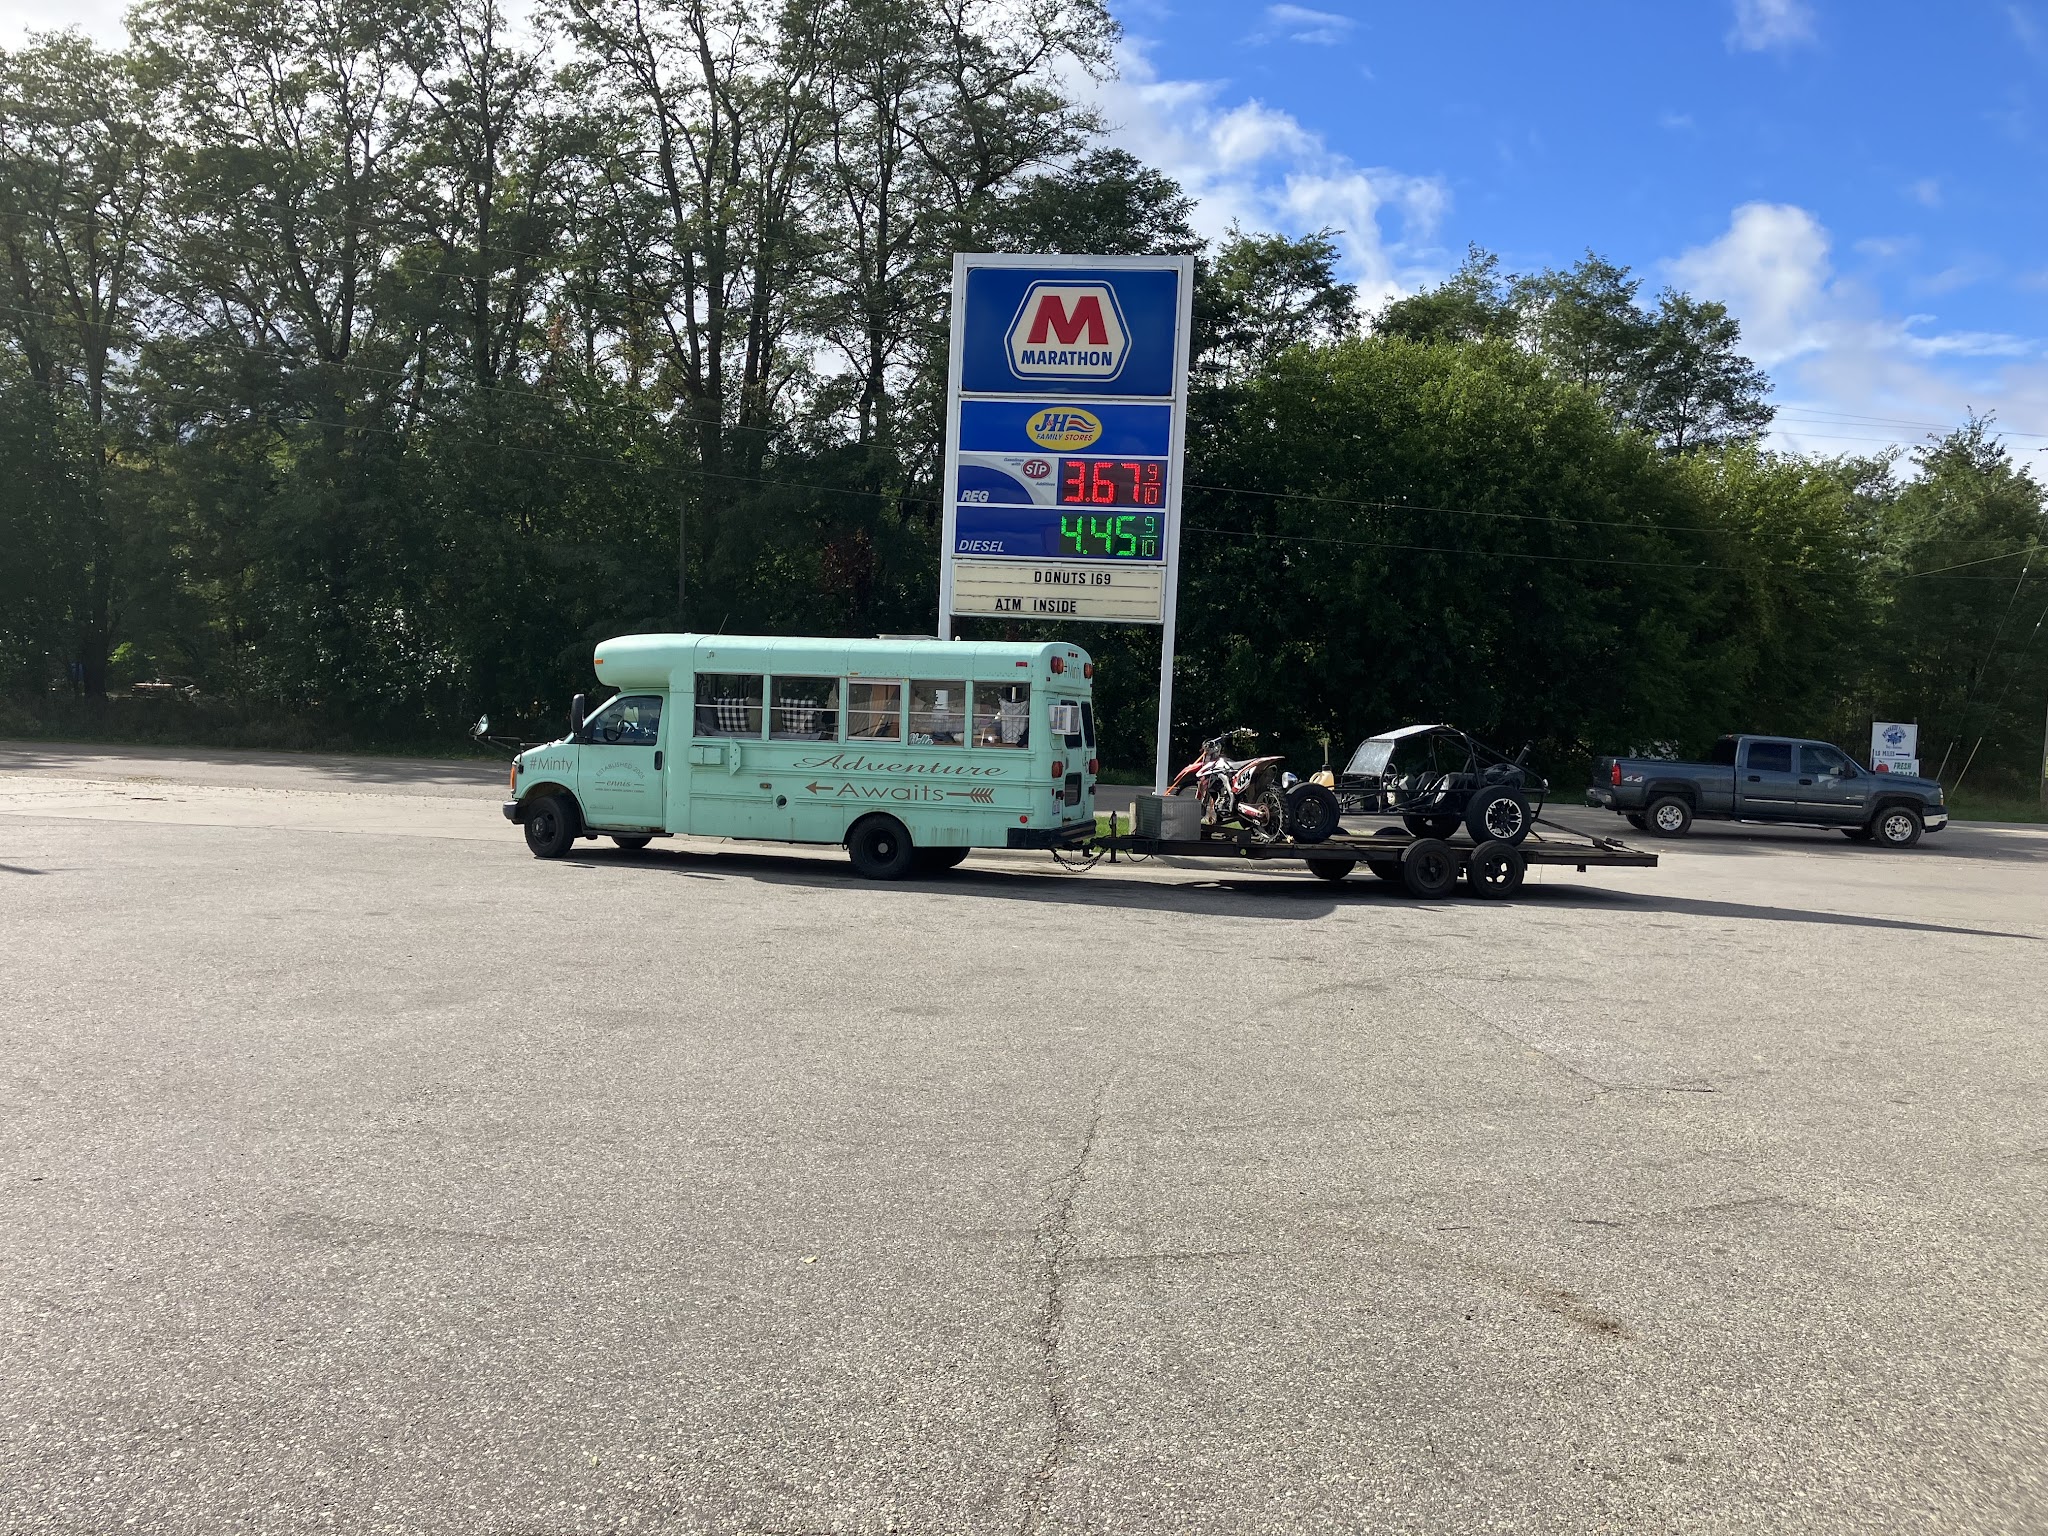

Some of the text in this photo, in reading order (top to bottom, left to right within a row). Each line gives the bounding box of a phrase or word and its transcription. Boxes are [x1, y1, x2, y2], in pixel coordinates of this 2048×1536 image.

[1027, 296, 1109, 345] M
[1021, 350, 1112, 366] MARATHON
[1036, 433, 1063, 441] FAMILY
[1025, 461, 1047, 476] STP
[961, 490, 990, 503] REG
[958, 540, 1005, 553] DIESEL
[1034, 571, 1111, 585] DONUTS 169
[1033, 599, 1077, 614] INSIDE
[529, 757, 573, 774] #Minty
[793, 754, 1008, 776] Adventure
[836, 782, 945, 802] Awaits
